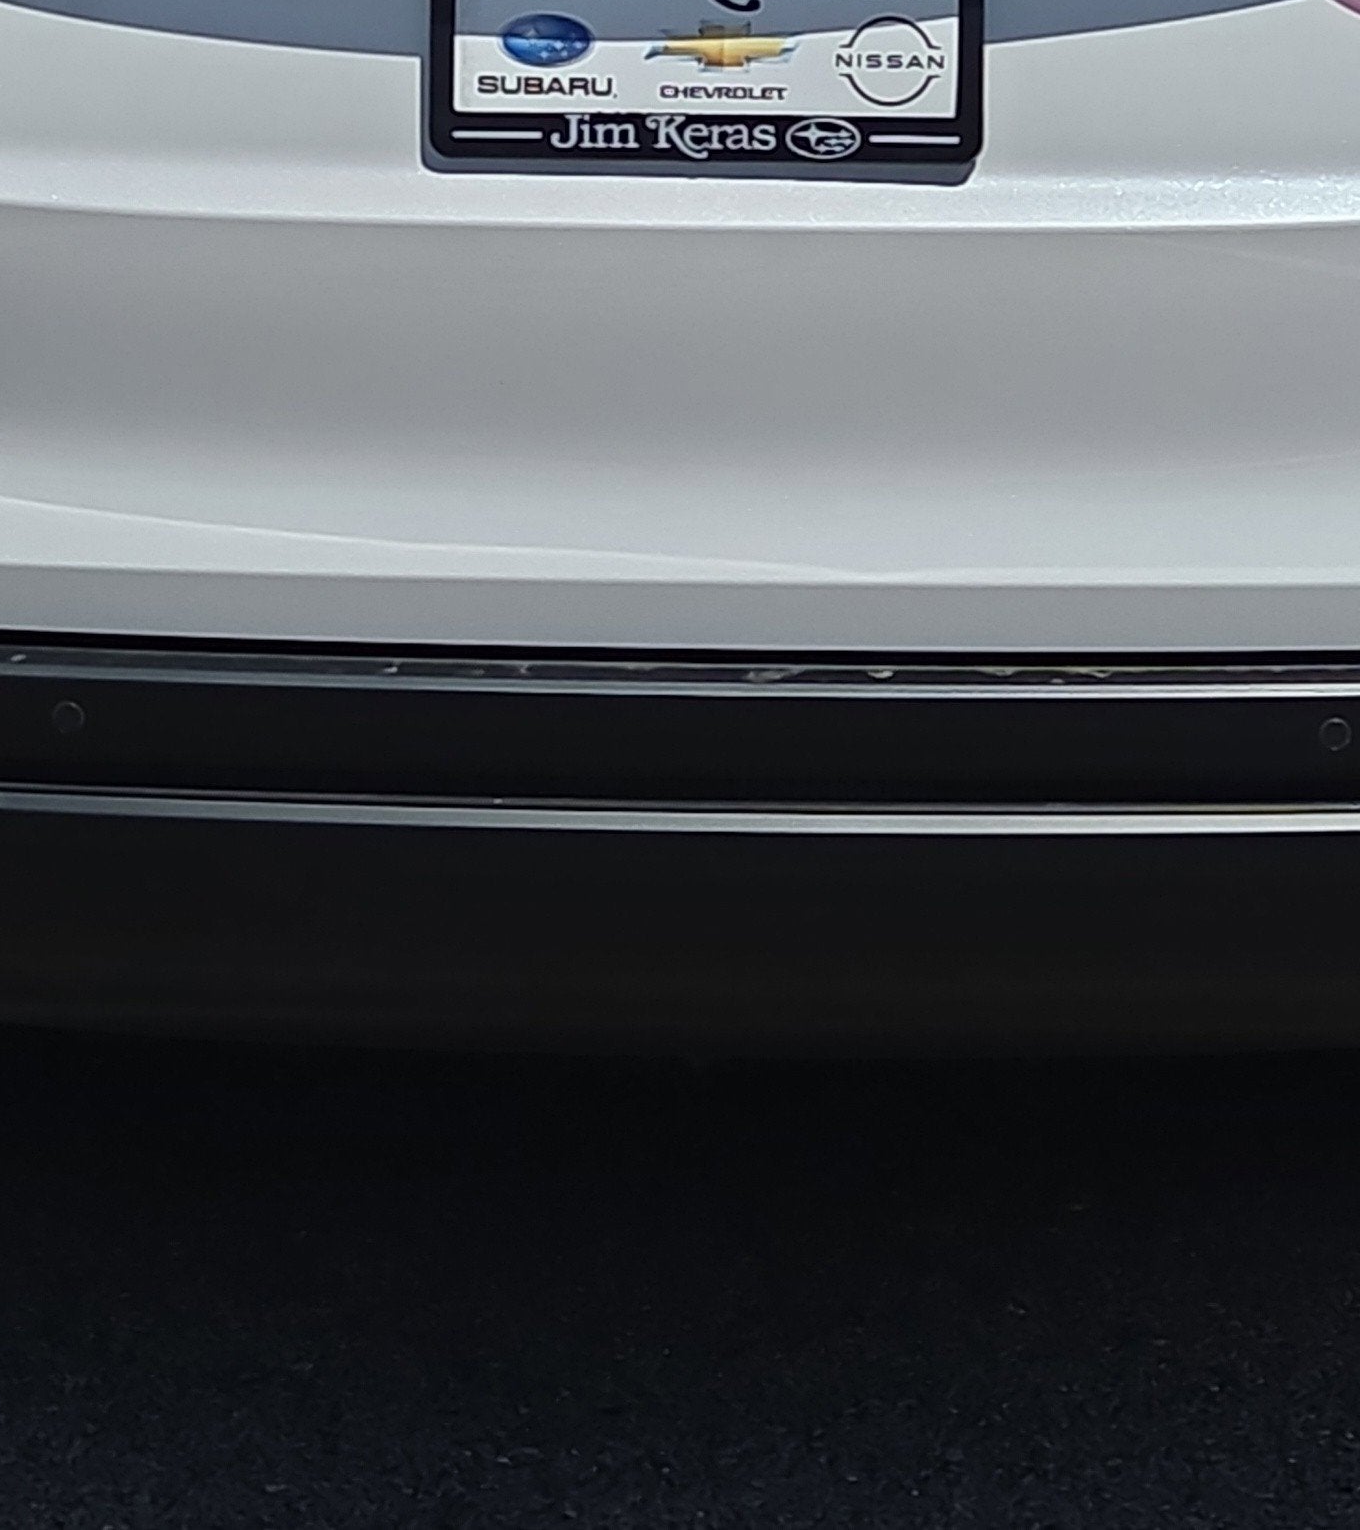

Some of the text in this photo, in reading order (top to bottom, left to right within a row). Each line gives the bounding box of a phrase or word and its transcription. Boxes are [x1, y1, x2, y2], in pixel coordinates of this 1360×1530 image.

[835, 52, 945, 70] NISSAN
[659, 84, 788, 101] CHEVROLET
[550, 113, 777, 160] Jim Keras
